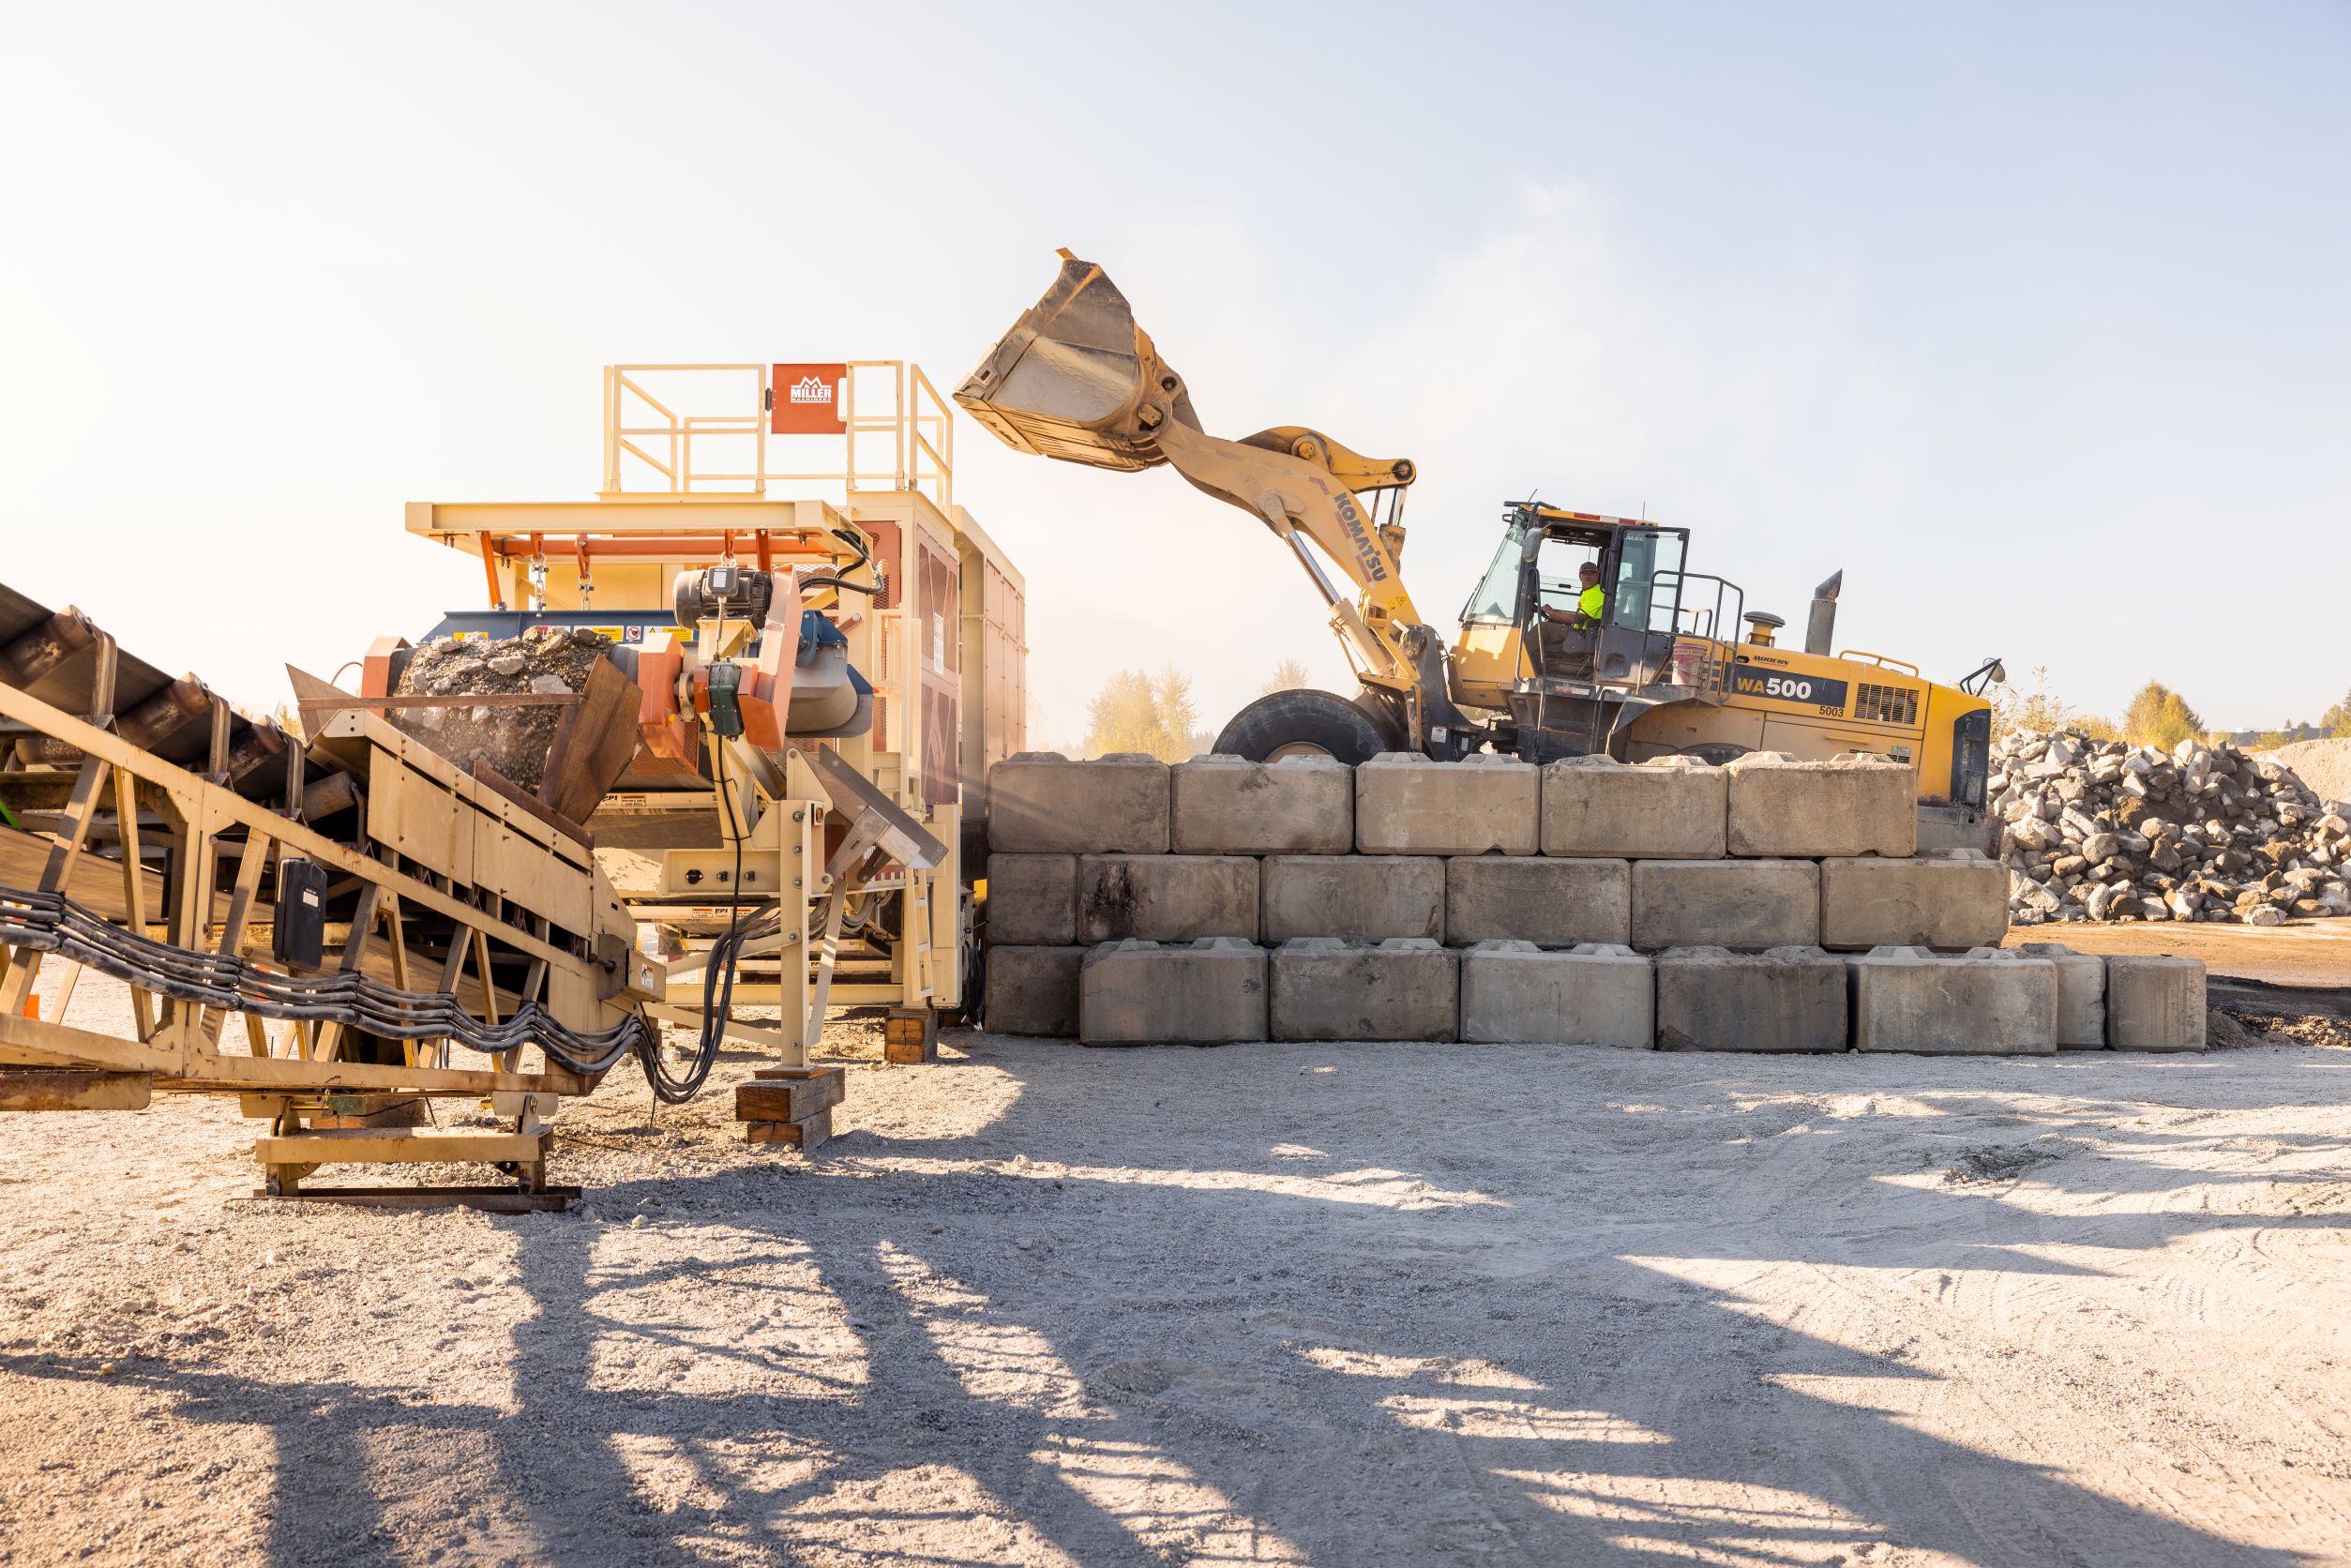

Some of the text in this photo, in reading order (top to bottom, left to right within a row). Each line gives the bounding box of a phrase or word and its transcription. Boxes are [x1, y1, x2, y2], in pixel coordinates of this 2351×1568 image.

[791, 388, 832, 399] MILLER
[1334, 491, 1388, 581] KOMATSU
[1753, 655, 1790, 666] MODERN
[1737, 677, 1812, 700] WA500
[1819, 705, 1845, 717] 5003
